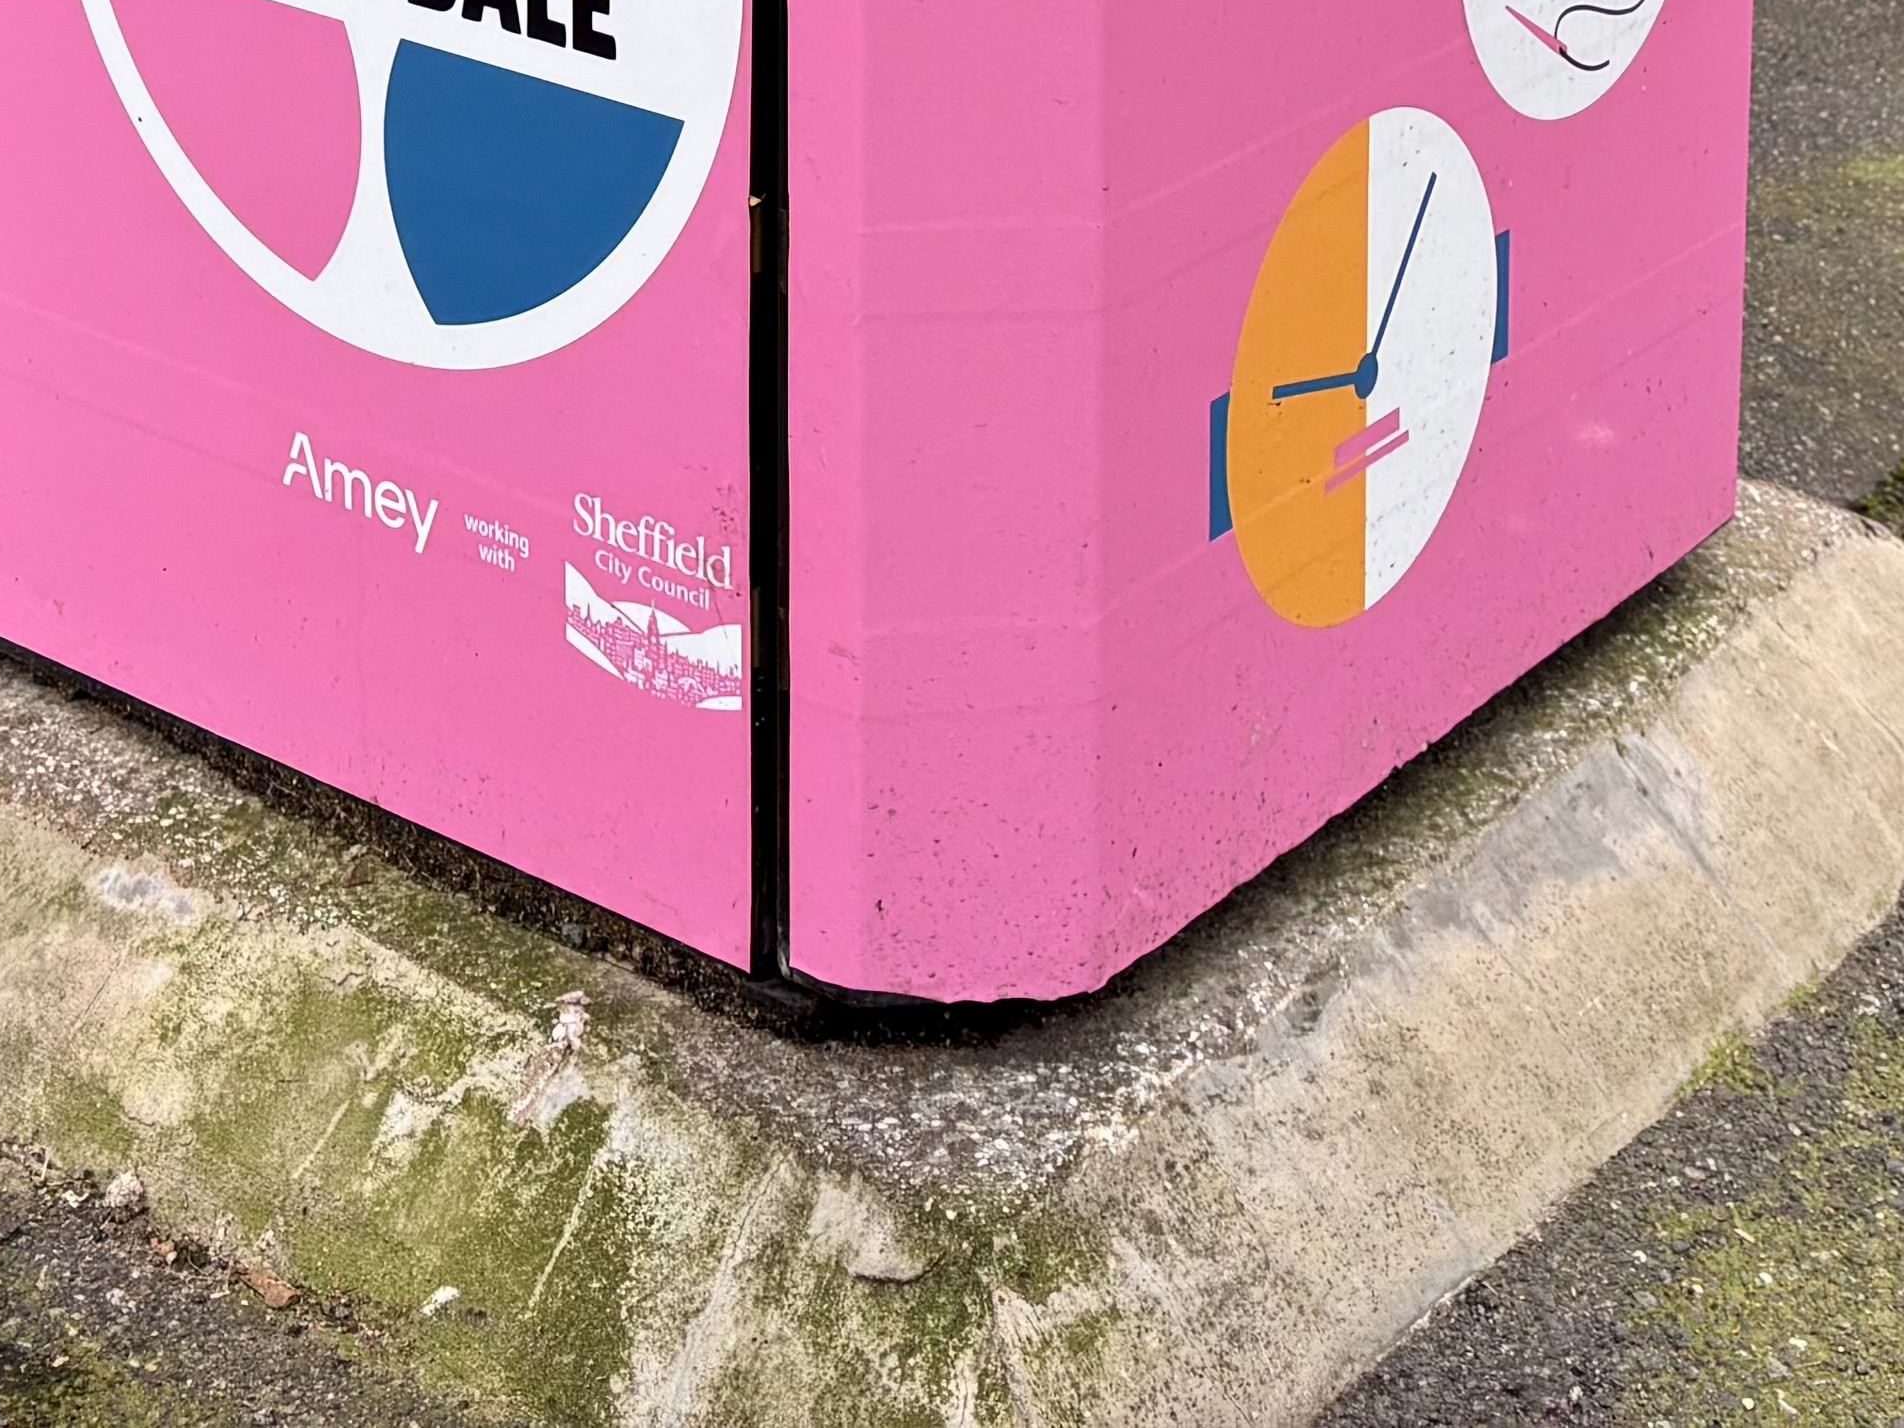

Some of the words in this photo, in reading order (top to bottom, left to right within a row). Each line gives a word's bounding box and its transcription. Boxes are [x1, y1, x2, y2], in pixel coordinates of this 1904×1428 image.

[282, 431, 439, 554] Amey
[464, 513, 529, 559] working
[478, 544, 515, 572] with
[572, 492, 733, 591] Sheffield
[594, 549, 632, 585] City
[637, 565, 710, 611] Council
